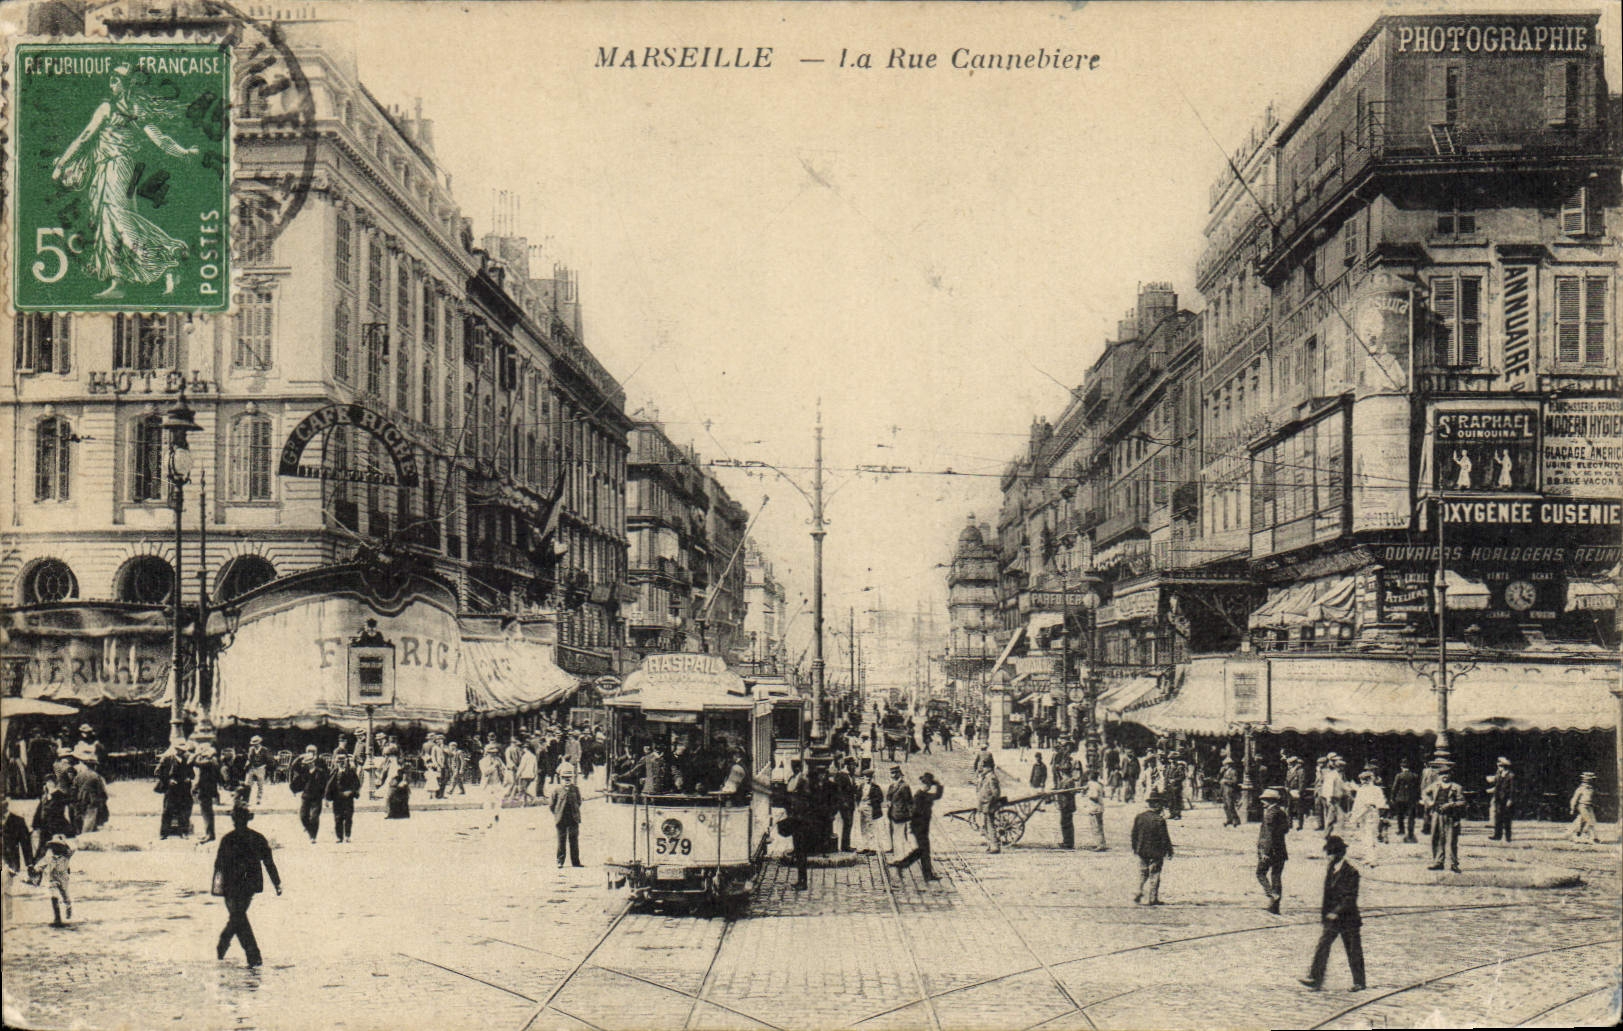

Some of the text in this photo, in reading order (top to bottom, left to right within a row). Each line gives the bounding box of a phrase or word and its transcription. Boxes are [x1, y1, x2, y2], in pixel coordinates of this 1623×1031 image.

[1398, 25, 1588, 52] PHOTOGRAPHIE
[138, 56, 221, 78] FRANÇAISE
[200, 210, 220, 295] POSTES
[1504, 266, 1530, 382] ANNUAIRE
[361, 409, 418, 476] RICHE
[1591, 446, 1623, 460] AMERIC
[1385, 546, 1463, 561] OUVRIERS
[1471, 547, 1565, 561] HORLOGERS
[647, 655, 718, 675] RASPAIL
[656, 837, 692, 855] 579
